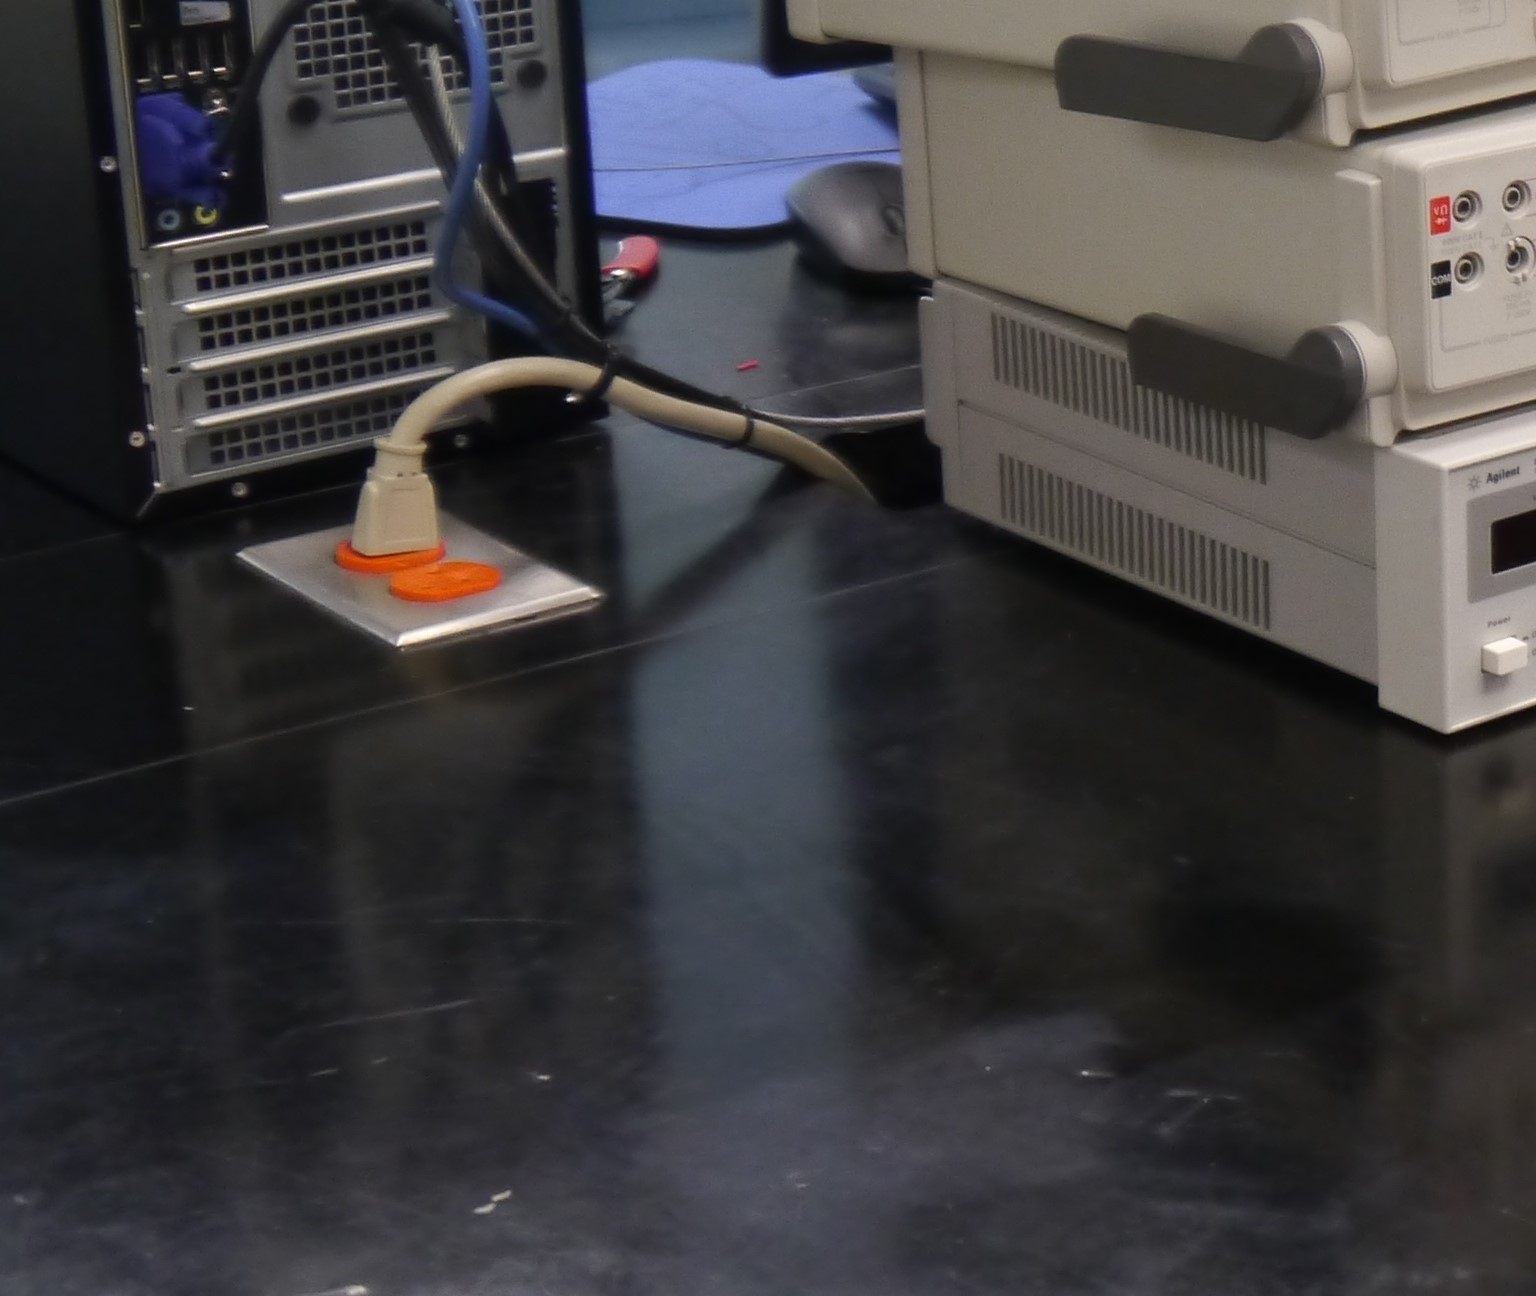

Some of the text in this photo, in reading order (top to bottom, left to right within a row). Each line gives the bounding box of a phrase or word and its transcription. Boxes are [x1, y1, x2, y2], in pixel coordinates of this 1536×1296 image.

[1431, 272, 1451, 286] COM
[1486, 464, 1521, 485] Agilent
[1487, 615, 1511, 629] Power
